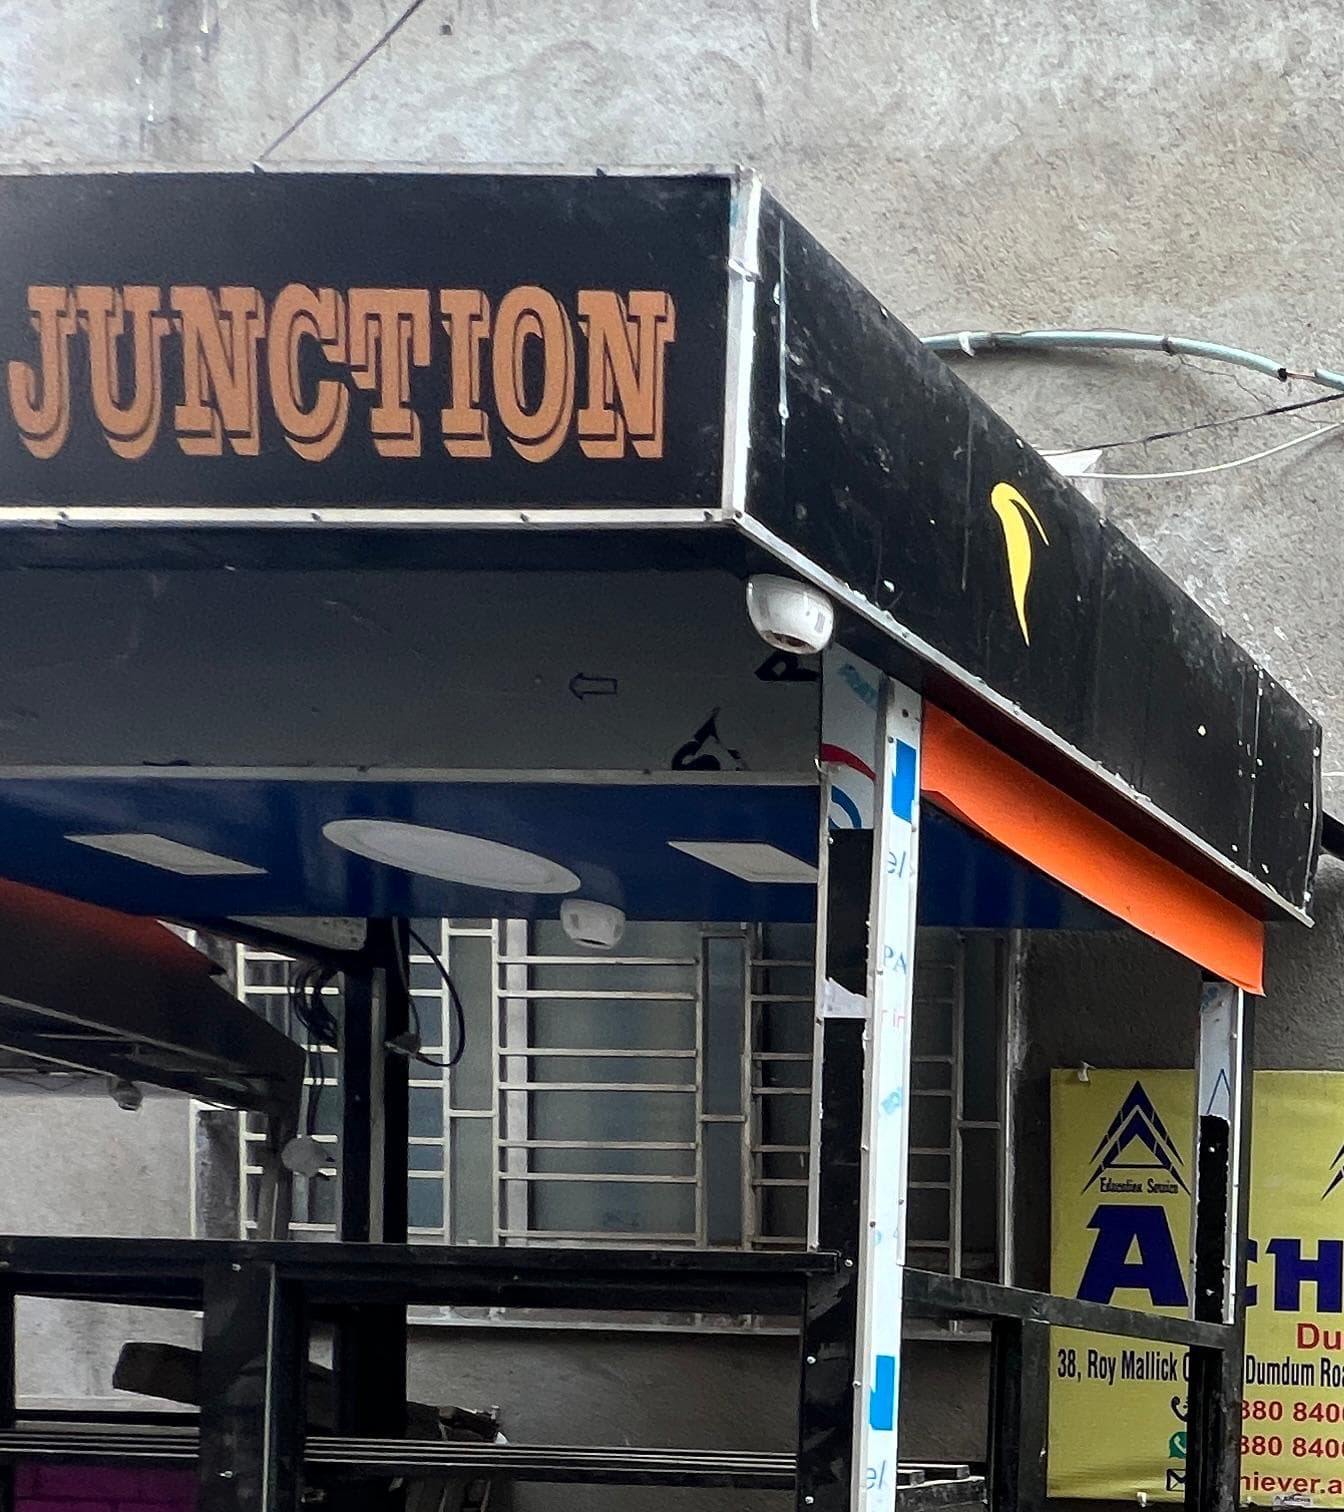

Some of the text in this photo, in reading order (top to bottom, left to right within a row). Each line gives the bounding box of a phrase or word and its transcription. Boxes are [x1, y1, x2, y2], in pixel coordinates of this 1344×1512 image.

[8, 283, 675, 462] JUNCTION
[1057, 1348, 1081, 1382] 38,
[1088, 1350, 1117, 1384] Roy
[1122, 1351, 1177, 1382] Mallick
[1246, 1355, 1314, 1387] Dumdum
